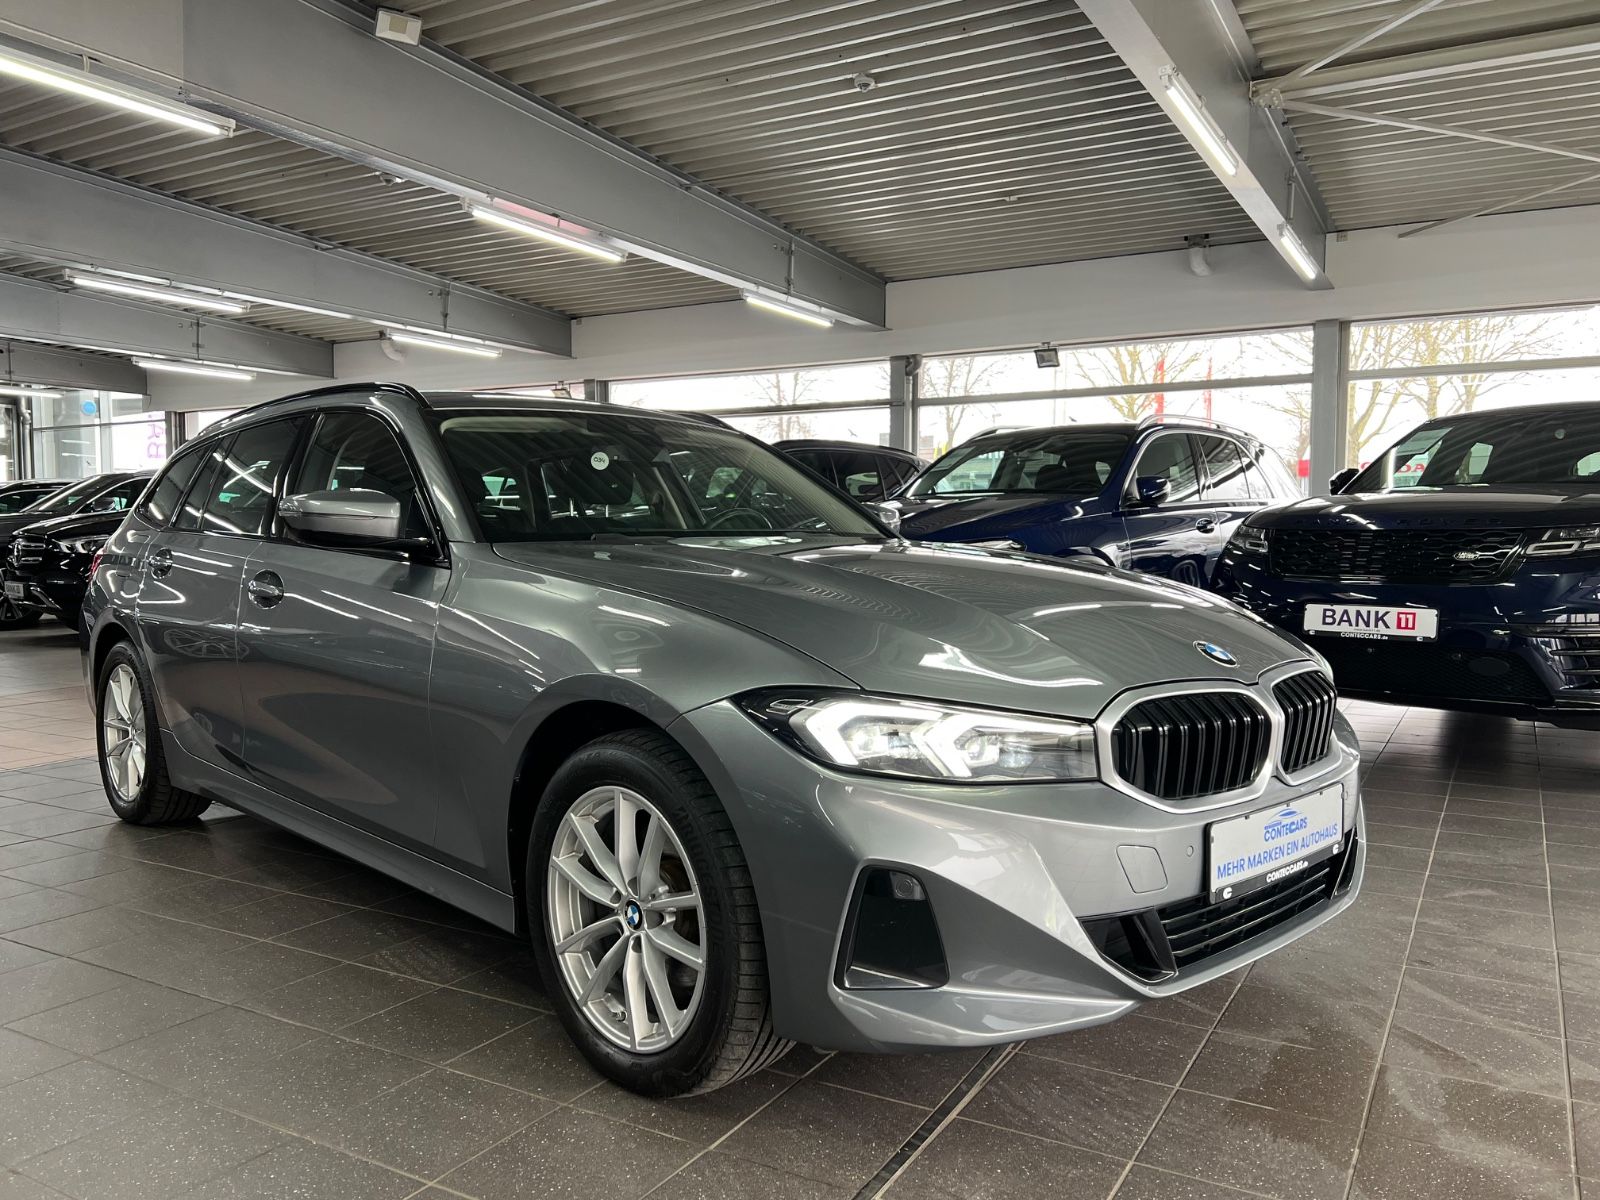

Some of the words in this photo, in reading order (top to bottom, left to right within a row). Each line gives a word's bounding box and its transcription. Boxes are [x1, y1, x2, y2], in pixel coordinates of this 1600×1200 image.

[1321, 608, 1391, 629] BANK
[1398, 613, 1416, 629] 11
[1263, 816, 1308, 842] CONTECARS
[1217, 855, 1246, 880] MEHR
[1247, 843, 1285, 870] MARKEN
[1286, 839, 1299, 856] EIN
[1300, 822, 1338, 850] AUTOHAUS
